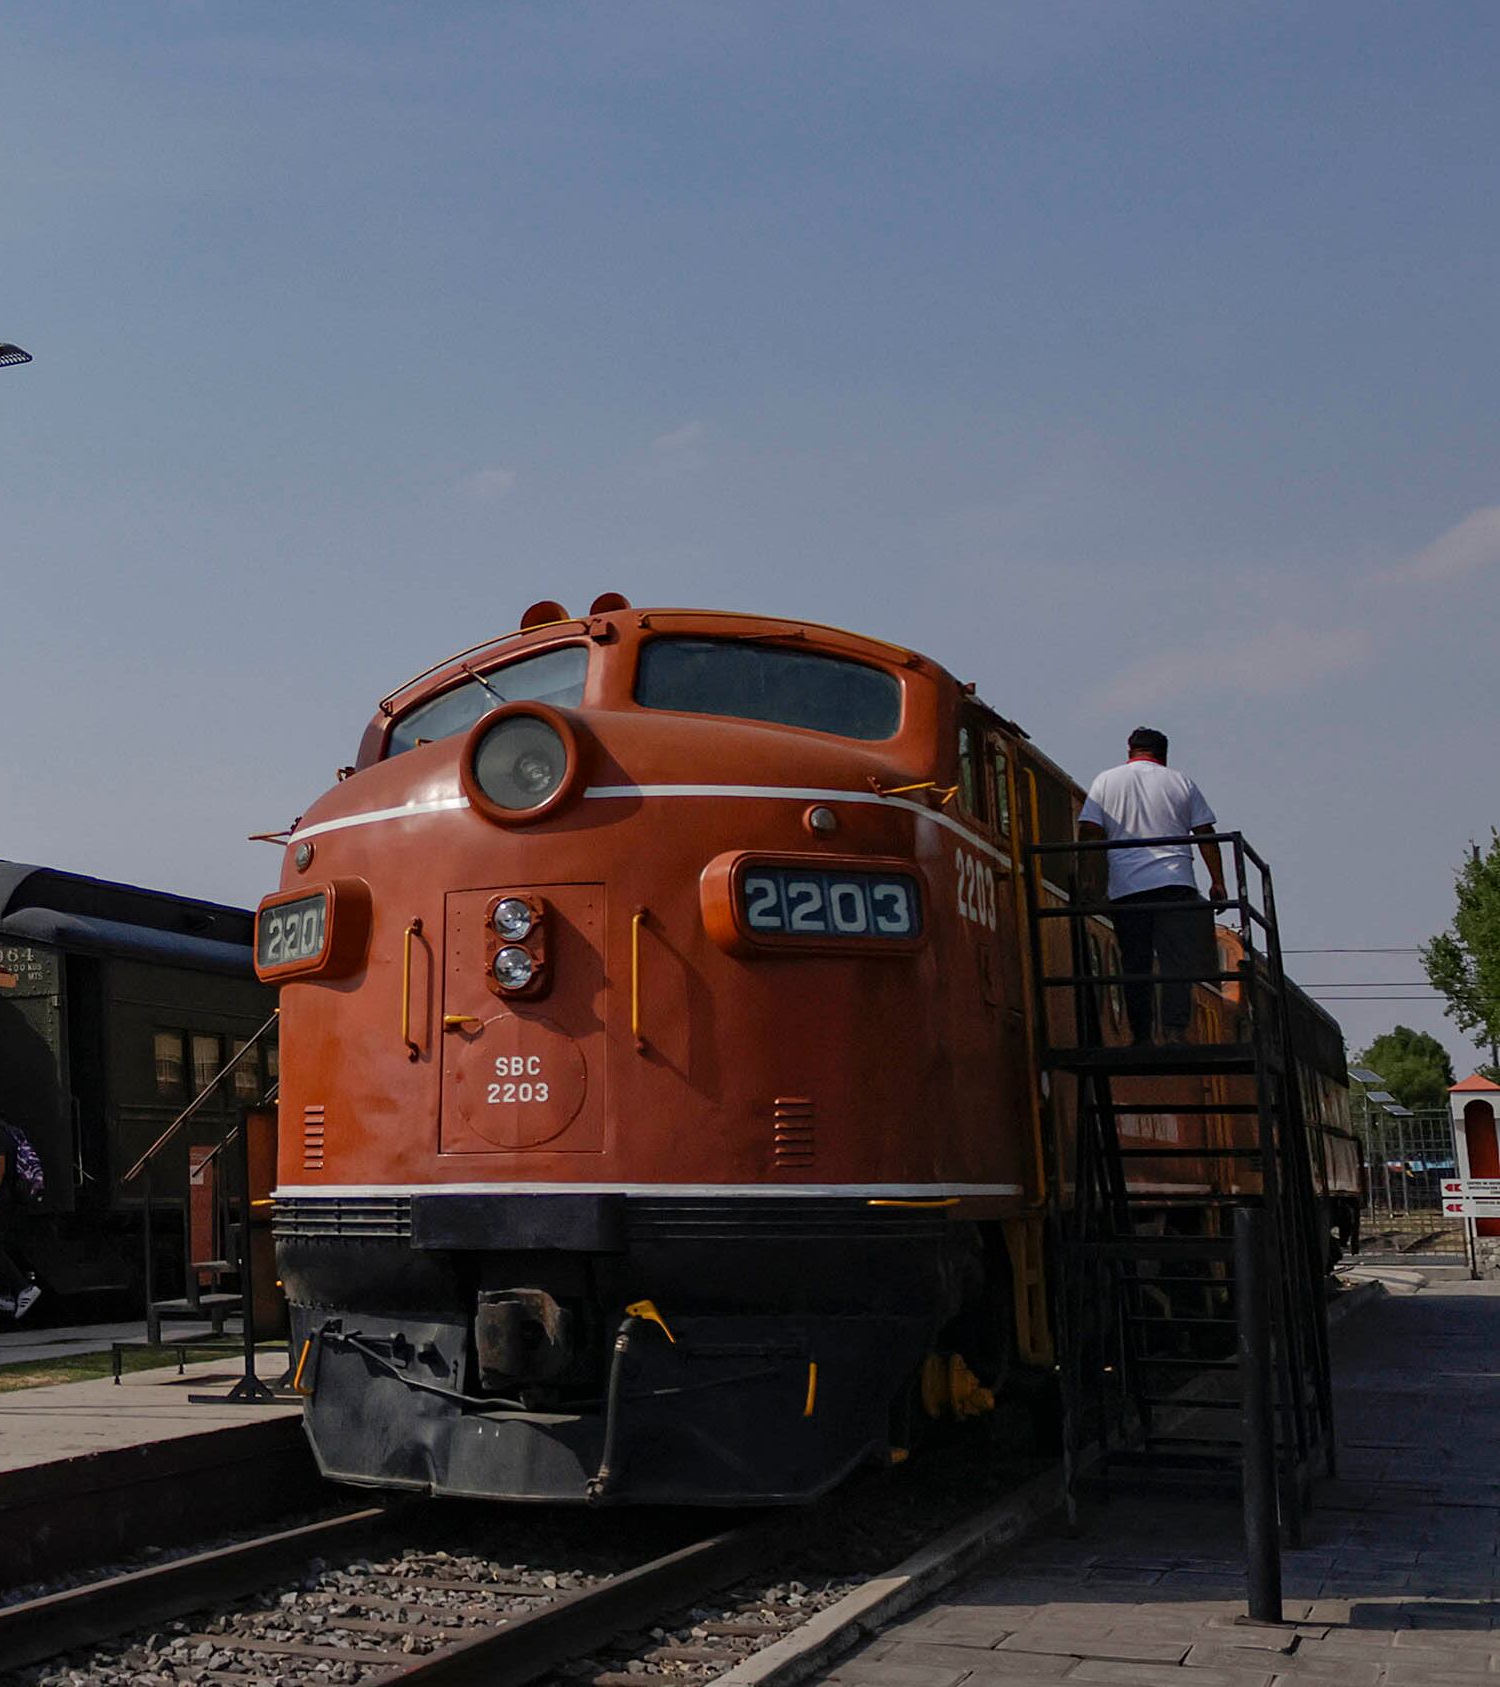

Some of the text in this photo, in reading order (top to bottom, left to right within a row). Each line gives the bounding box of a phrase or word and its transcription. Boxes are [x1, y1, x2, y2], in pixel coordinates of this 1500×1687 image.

[745, 878, 910, 933] 2203
[955, 847, 997, 933] 2203
[495, 1055, 541, 1077] SBC
[487, 1082, 549, 1104] 2203
